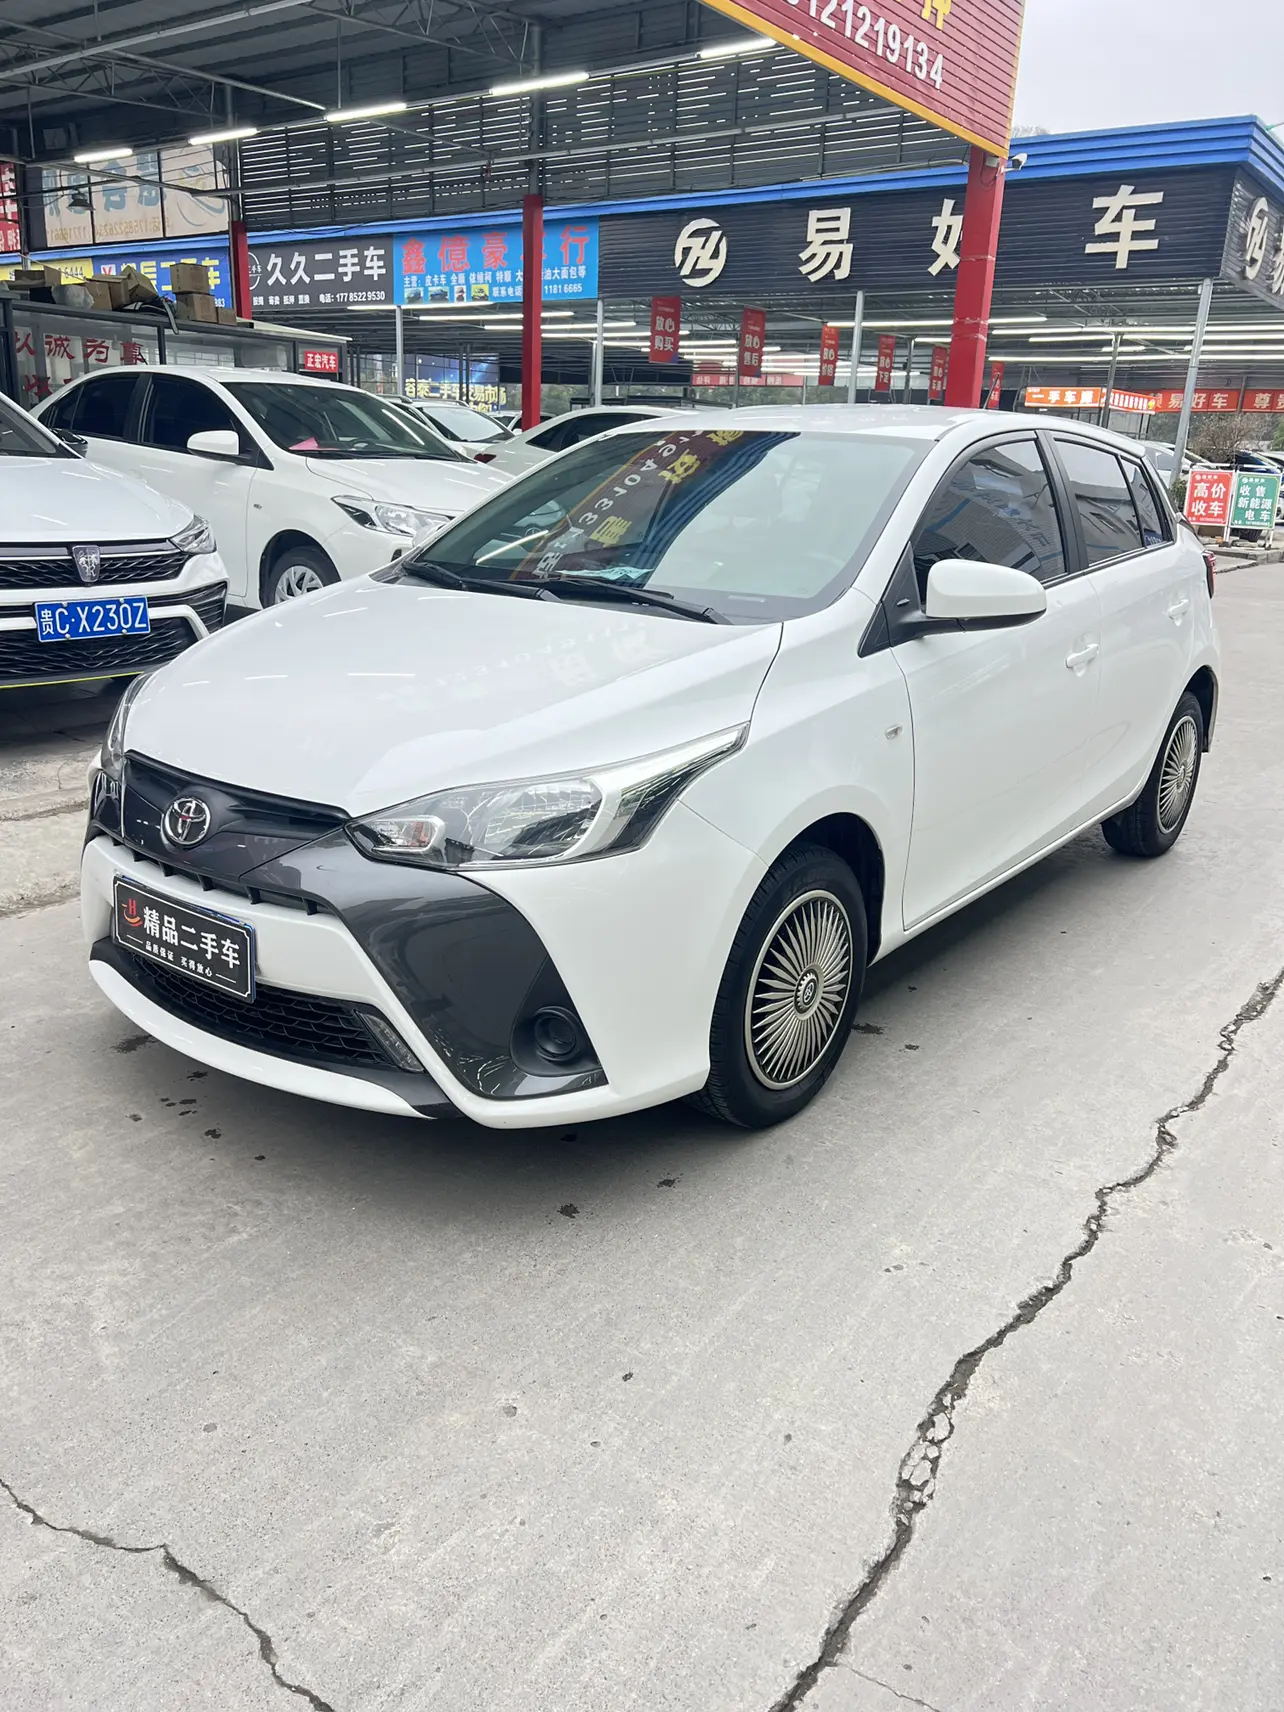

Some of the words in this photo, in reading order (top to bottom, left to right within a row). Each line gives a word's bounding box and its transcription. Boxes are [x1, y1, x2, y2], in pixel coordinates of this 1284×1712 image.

[402, 225, 589, 275] 鑫億豪行
[266, 246, 386, 286] 久久二手车
[425, 273, 447, 287] 皮卡车
[655, 315, 675, 332] 放心
[654, 335, 674, 351] 购买
[744, 334, 760, 349] 放心
[306, 353, 337, 370] 正宏汽车
[1194, 482, 1227, 499] 高价
[1191, 500, 1224, 517] 收车
[1237, 497, 1273, 510] 新能源
[1245, 510, 1271, 522] 电车
[143, 906, 241, 970] 精品二手车
[145, 940, 174, 962] 品质保证
[180, 956, 213, 978] 买得放心
